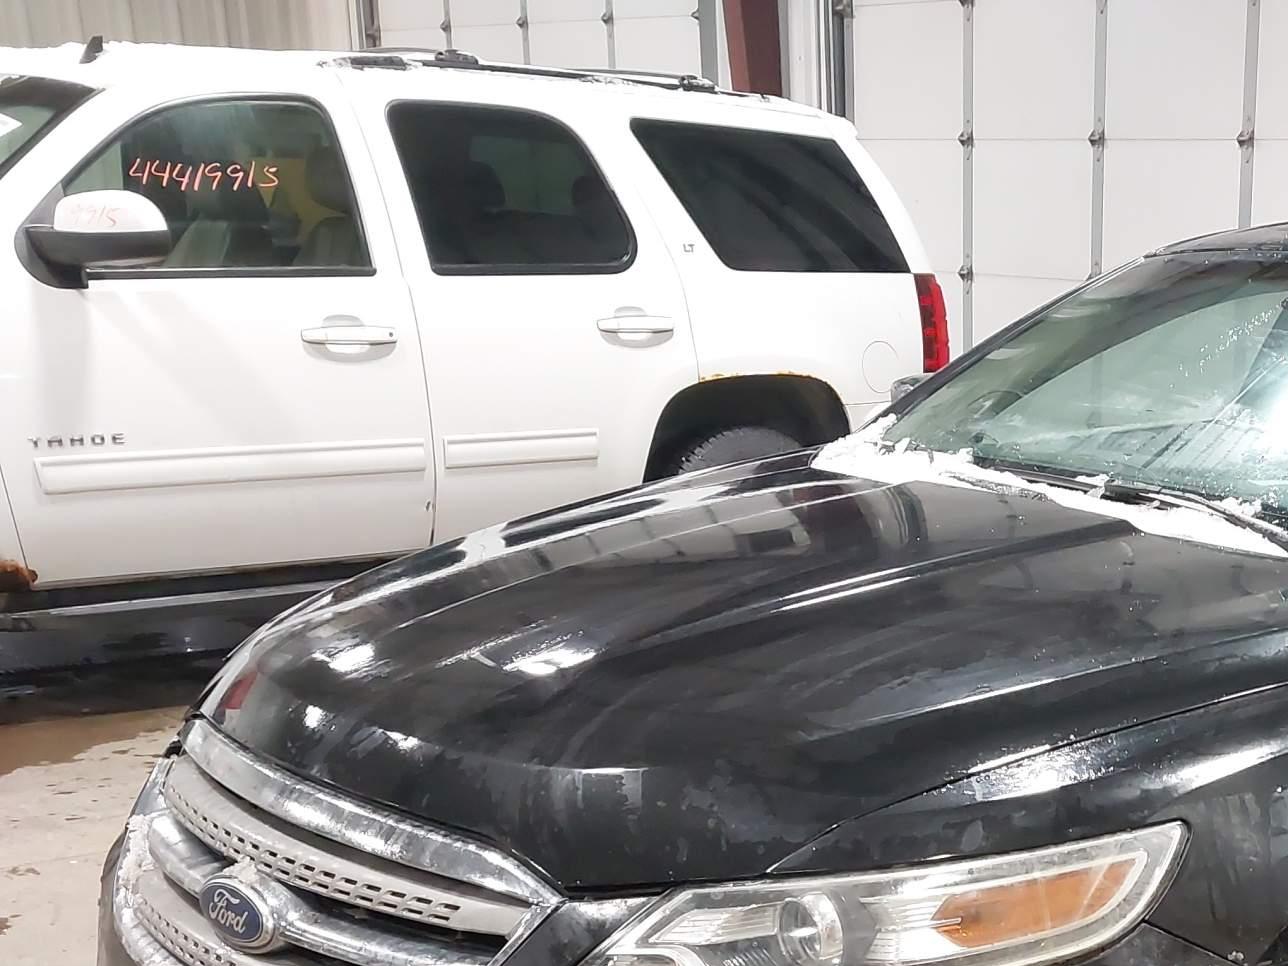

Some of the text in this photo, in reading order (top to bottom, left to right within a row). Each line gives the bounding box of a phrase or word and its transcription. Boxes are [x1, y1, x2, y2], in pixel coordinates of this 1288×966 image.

[129, 157, 280, 192] 44419915
[682, 243, 695, 253] LT
[27, 432, 127, 448] TAHOE
[208, 888, 248, 934] Ford
